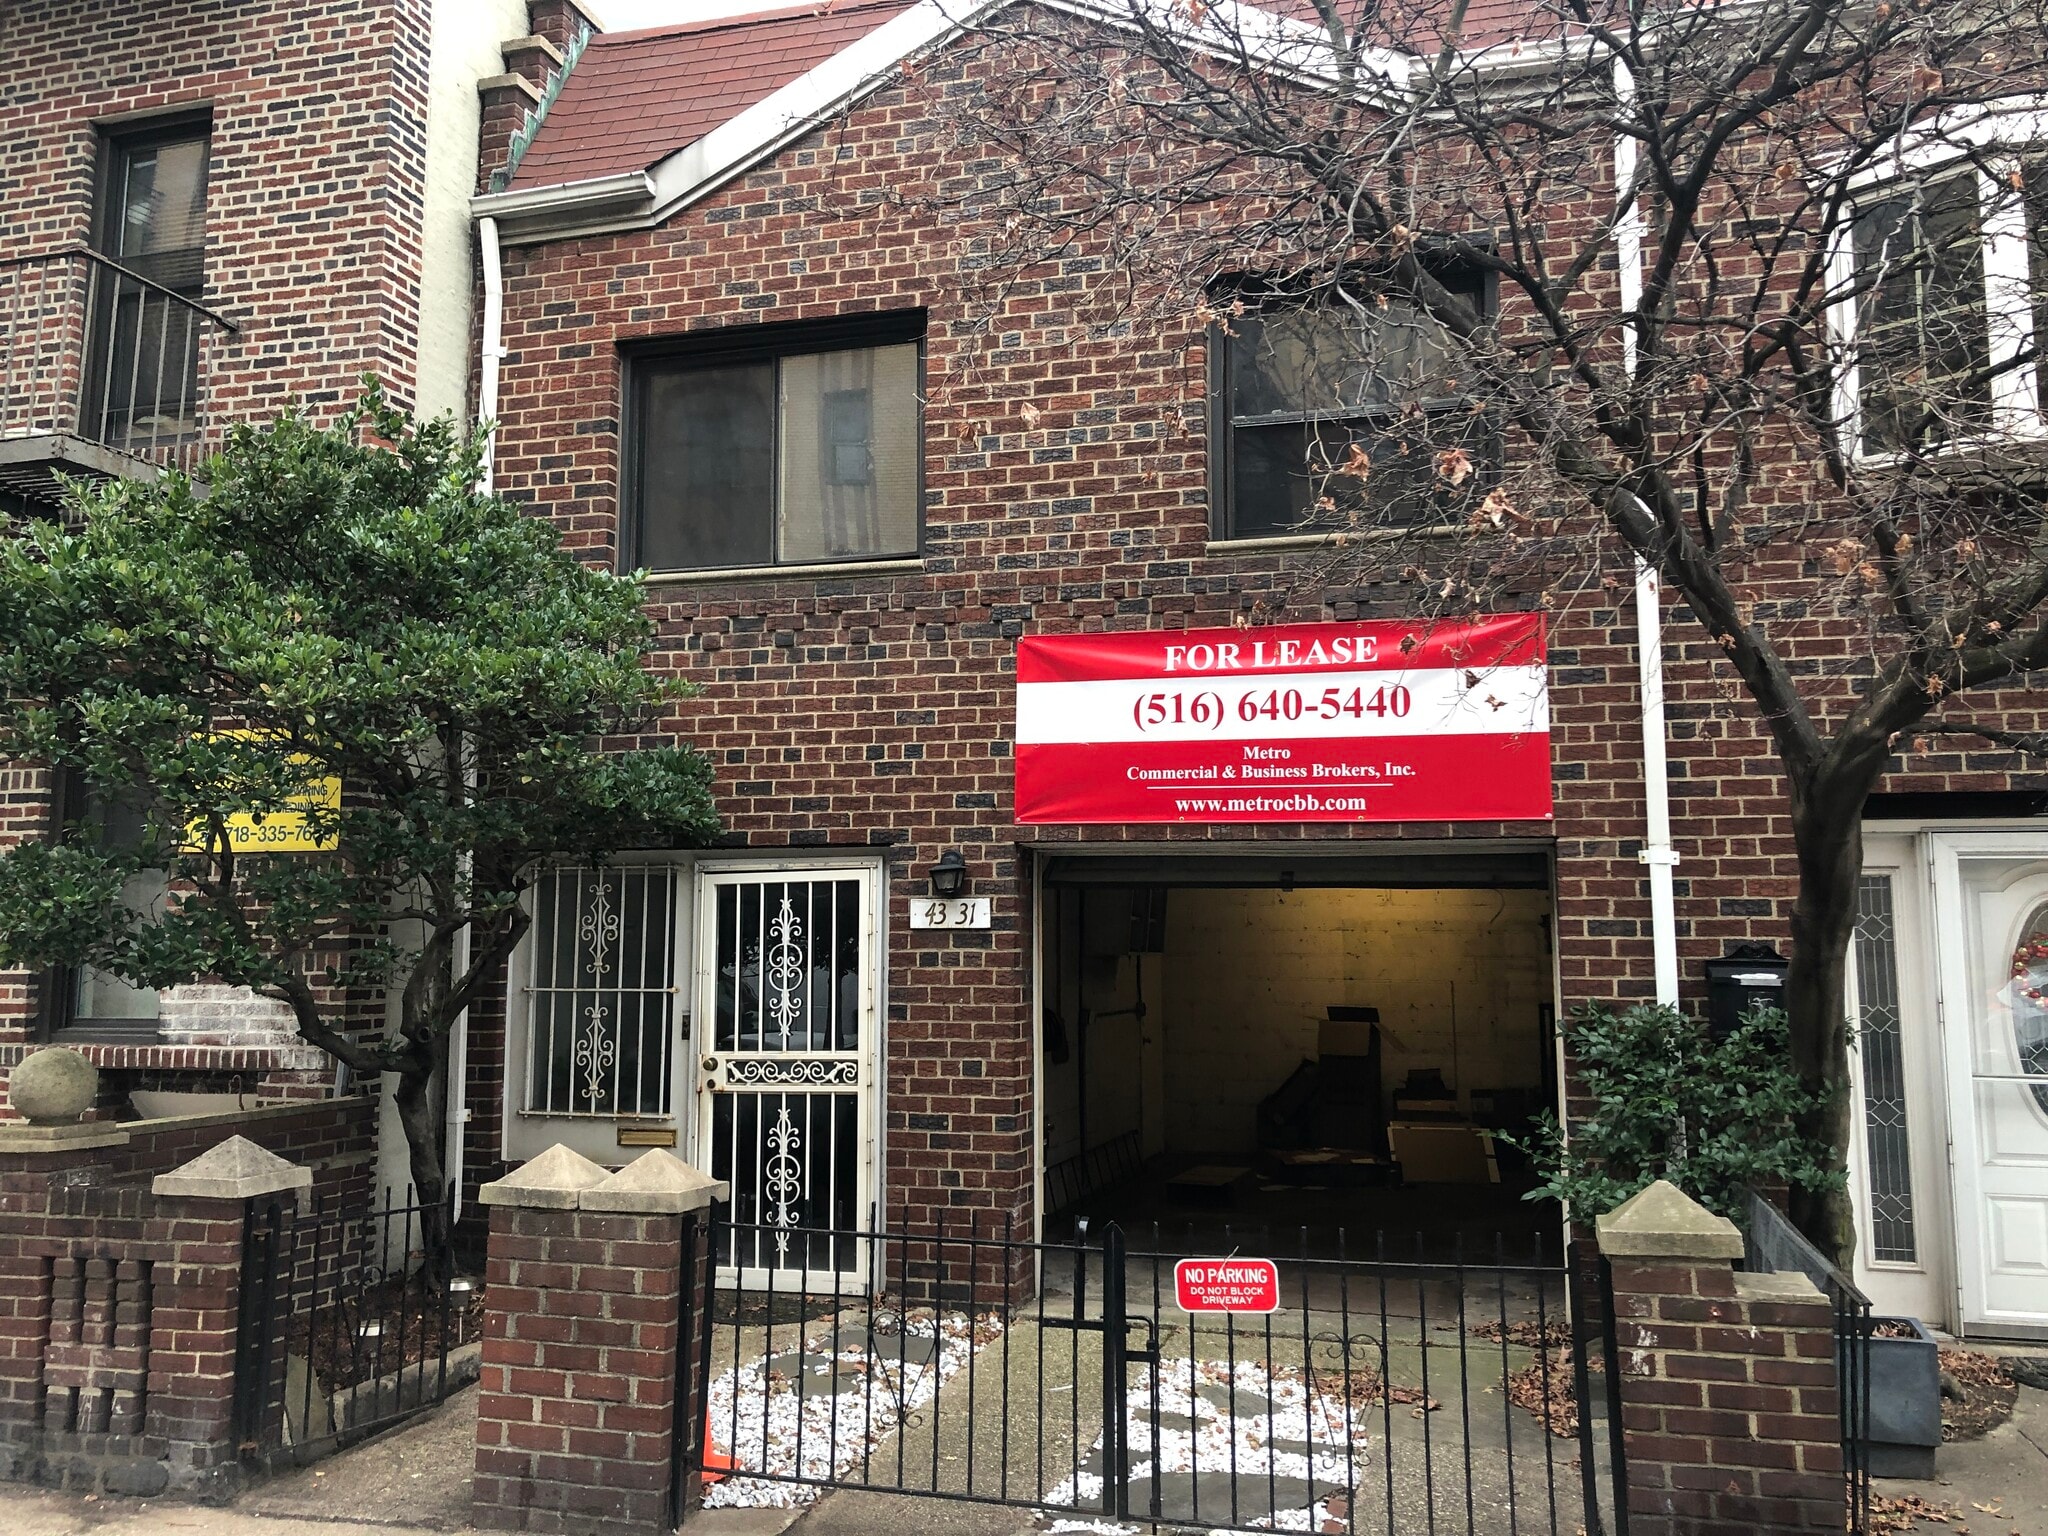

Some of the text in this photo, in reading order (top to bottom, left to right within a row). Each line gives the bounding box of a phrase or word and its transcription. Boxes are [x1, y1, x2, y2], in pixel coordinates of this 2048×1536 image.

[1163, 636, 1379, 672] FOR LEASE
[1134, 685, 1411, 732] (516) 640-5440
[1243, 746, 1291, 760] Metro
[1126, 762, 1416, 780] Commercial & Business Brokers, Inc.
[1175, 794, 1366, 813] www.metrocbb.com
[925, 902, 976, 926] 43 31
[1185, 1268, 1267, 1283] NO PARKING
[1190, 1286, 1264, 1295] DO NOT BLOCK
[1202, 1296, 1253, 1304] DRIVEWAY
